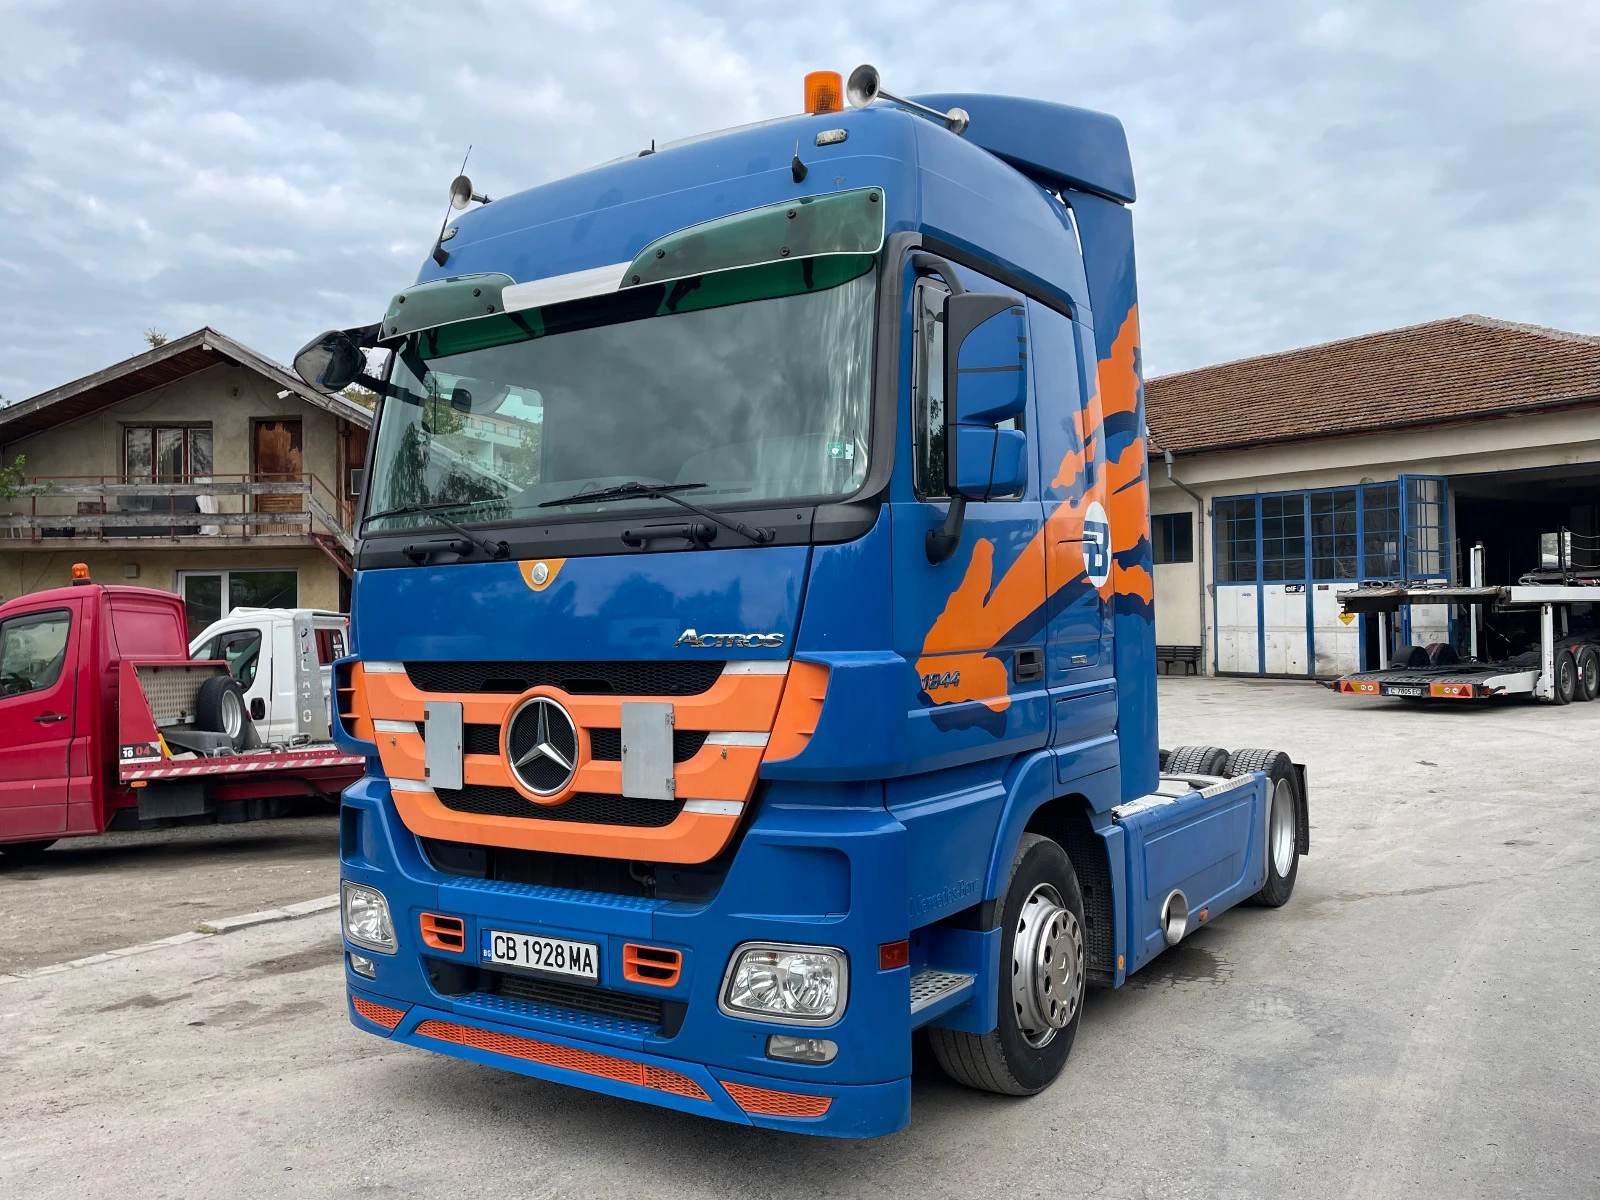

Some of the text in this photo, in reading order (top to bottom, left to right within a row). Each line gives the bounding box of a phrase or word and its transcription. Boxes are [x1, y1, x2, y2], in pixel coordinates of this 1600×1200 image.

[1285, 585, 1297, 593] elf
[921, 671, 960, 690] 1844
[135, 745, 151, 756] 04
[483, 949, 492, 957] BG
[494, 935, 594, 974] CB 1928 MA
